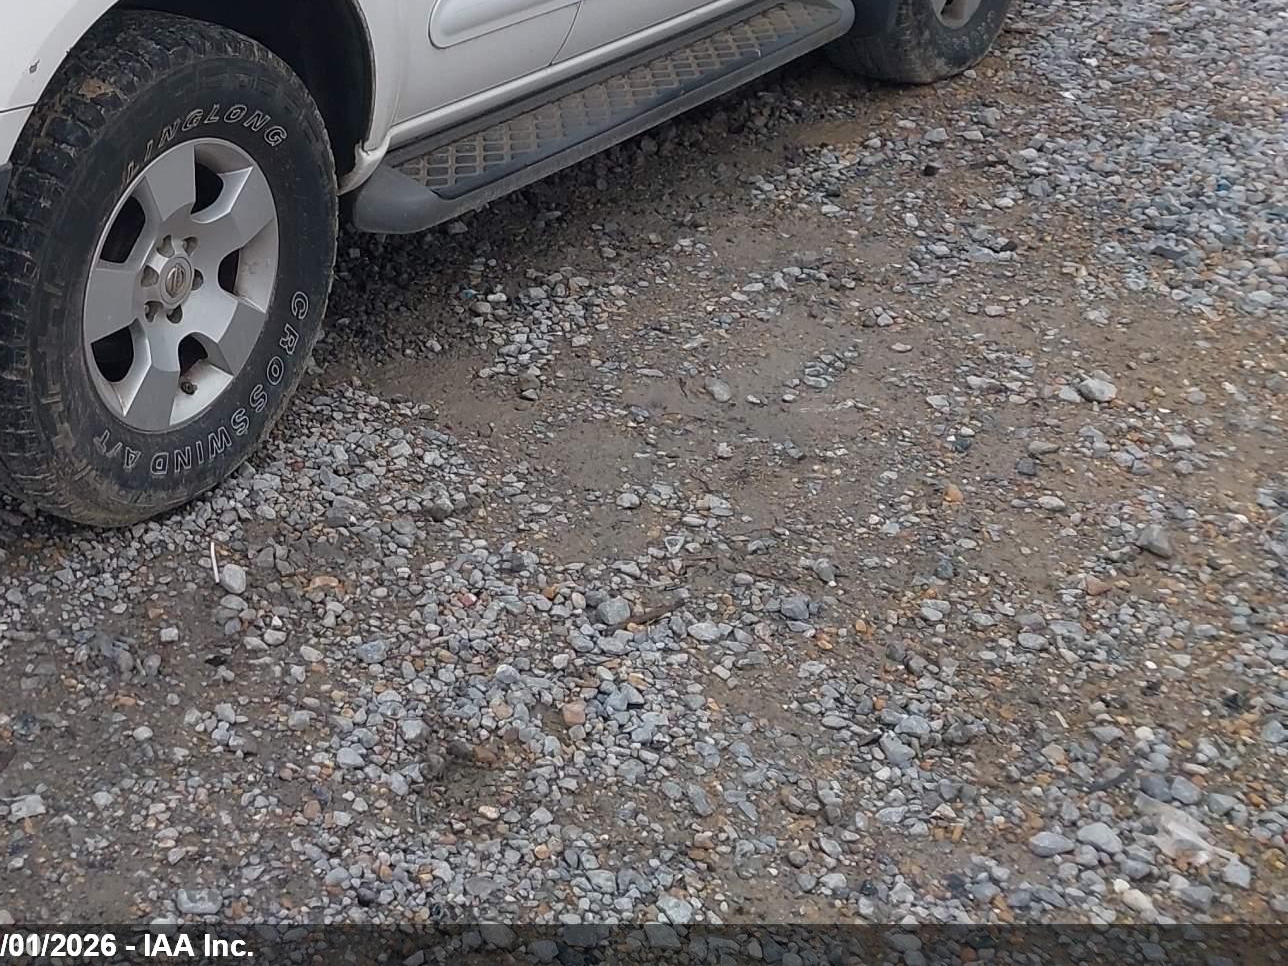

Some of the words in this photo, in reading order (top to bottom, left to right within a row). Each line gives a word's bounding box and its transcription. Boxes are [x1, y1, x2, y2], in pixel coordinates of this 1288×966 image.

[125, 103, 288, 184] LINGLONG
[150, 290, 310, 476] CROSSWIND
[93, 430, 142, 470] A/T
